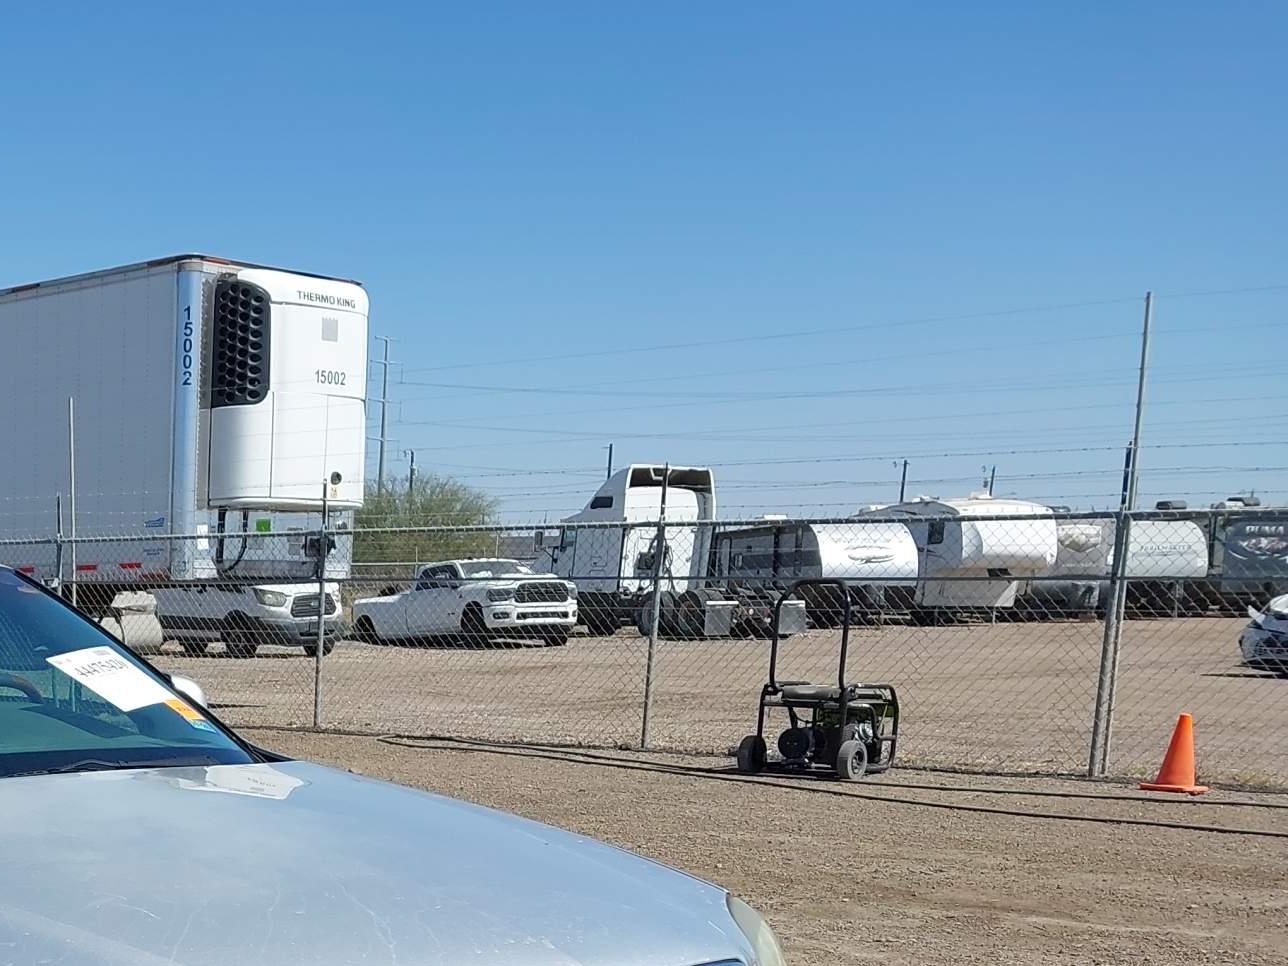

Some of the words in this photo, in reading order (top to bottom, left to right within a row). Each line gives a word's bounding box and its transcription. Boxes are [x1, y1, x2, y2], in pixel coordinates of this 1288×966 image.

[297, 291, 336, 305] THERMO
[337, 297, 356, 309] KING
[182, 306, 193, 386] 15002
[315, 369, 346, 386] 15002
